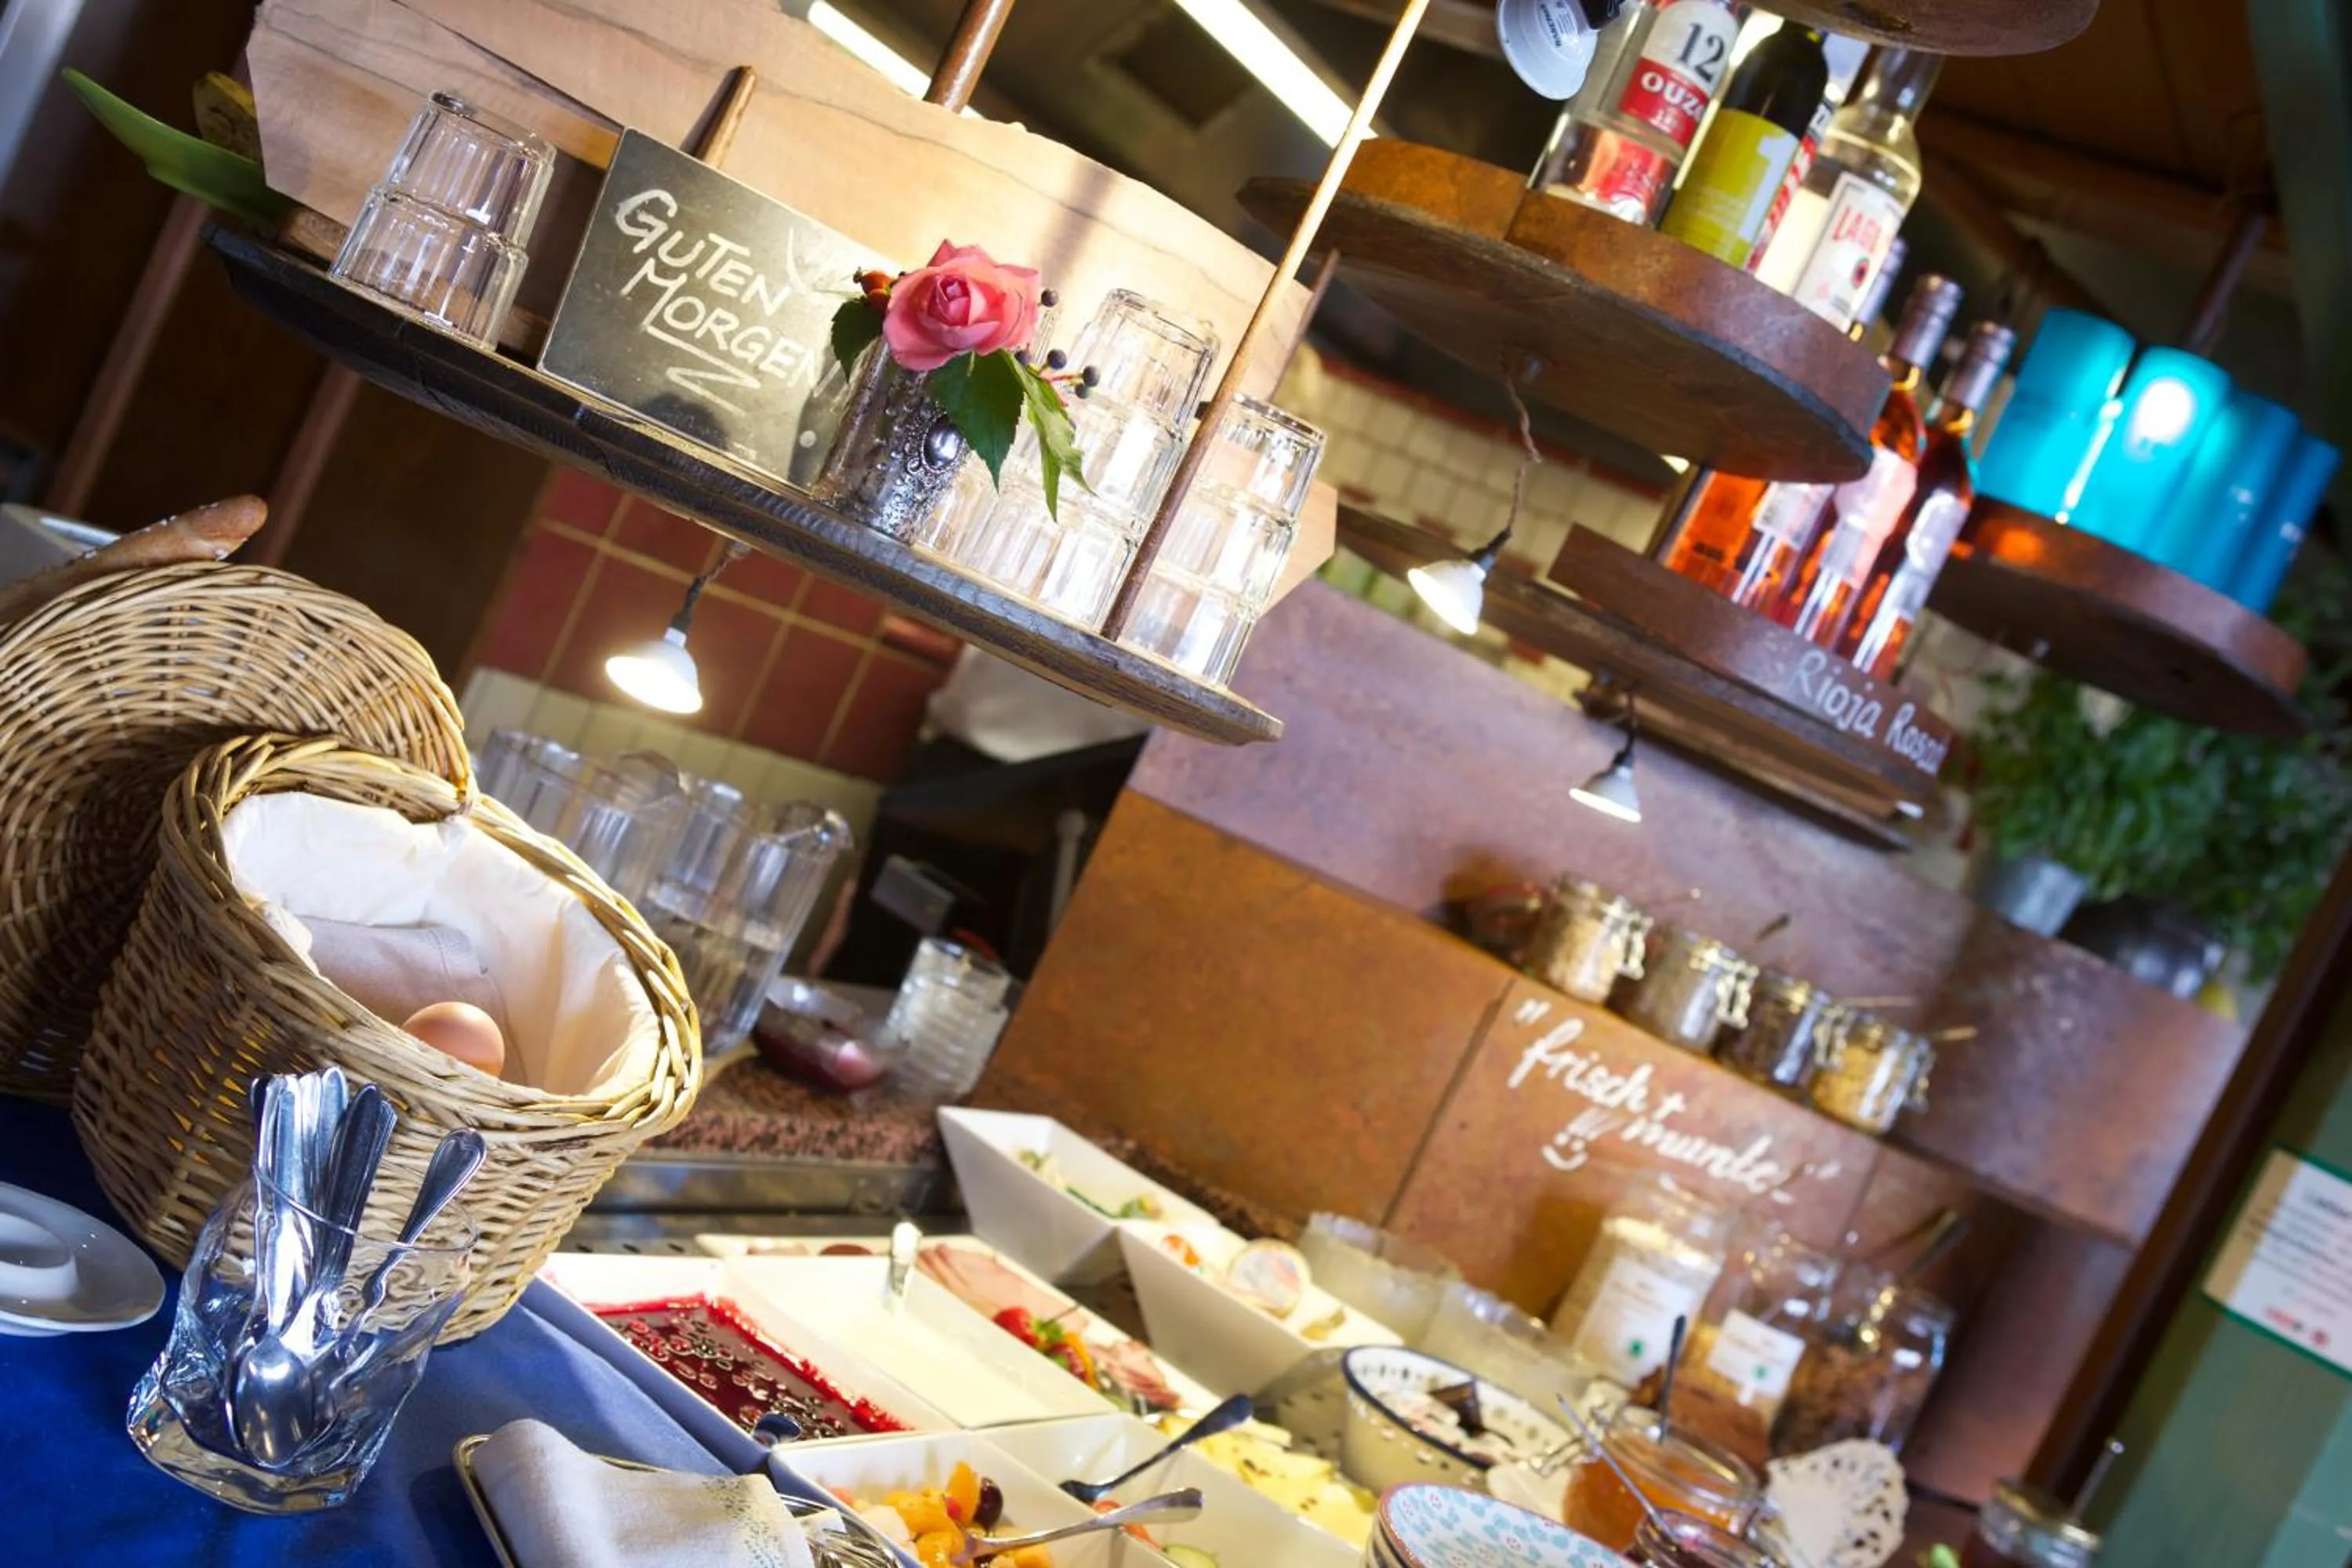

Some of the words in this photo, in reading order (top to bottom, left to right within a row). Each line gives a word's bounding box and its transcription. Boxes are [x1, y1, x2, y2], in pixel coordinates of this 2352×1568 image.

[1676, 22, 1725, 83] 12
[615, 189, 793, 315] GUTEN
[619, 257, 842, 398] MORGEN
[1790, 650, 1882, 737] Rioja
